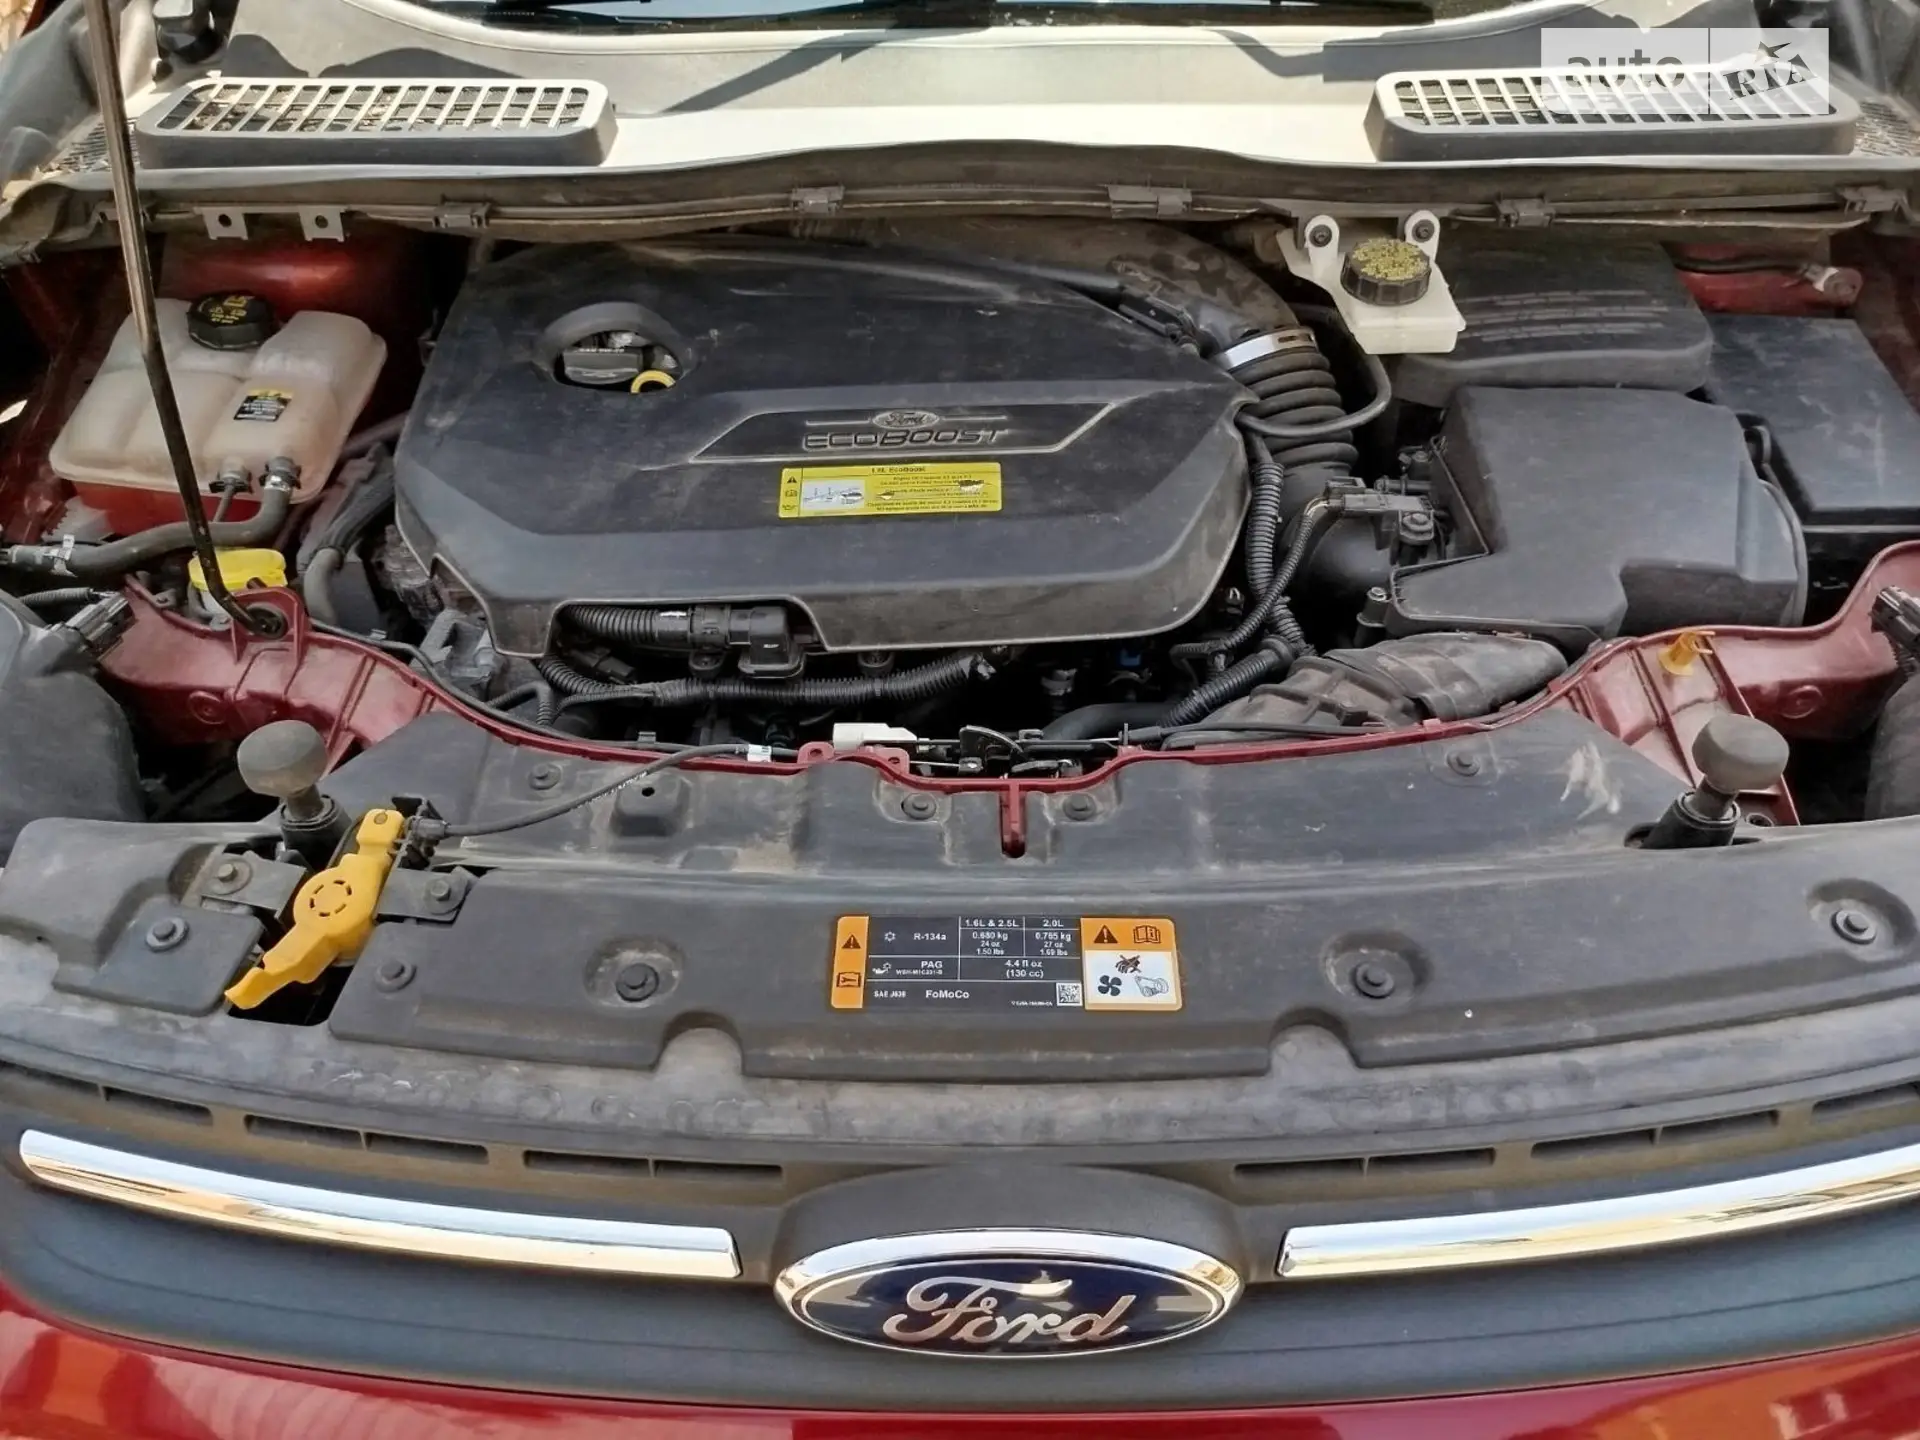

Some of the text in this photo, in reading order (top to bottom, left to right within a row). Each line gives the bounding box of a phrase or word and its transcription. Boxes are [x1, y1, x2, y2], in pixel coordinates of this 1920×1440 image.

[965, 919, 1019, 927] 1.6L & 2.5L
[1043, 919, 1064, 927] 2.0L
[913, 932, 947, 941] R-134a
[997, 931, 1009, 941] kg
[1060, 932, 1072, 942] kg
[920, 960, 943, 969] PAG
[1004, 959, 1020, 967] 4.4
[1021, 959, 1029, 967] fl
[1006, 969, 1044, 979] (130 cc)
[873, 990, 889, 998] SAE
[925, 989, 970, 999] FoMoCo
[882, 1275, 1137, 1344] Ford
